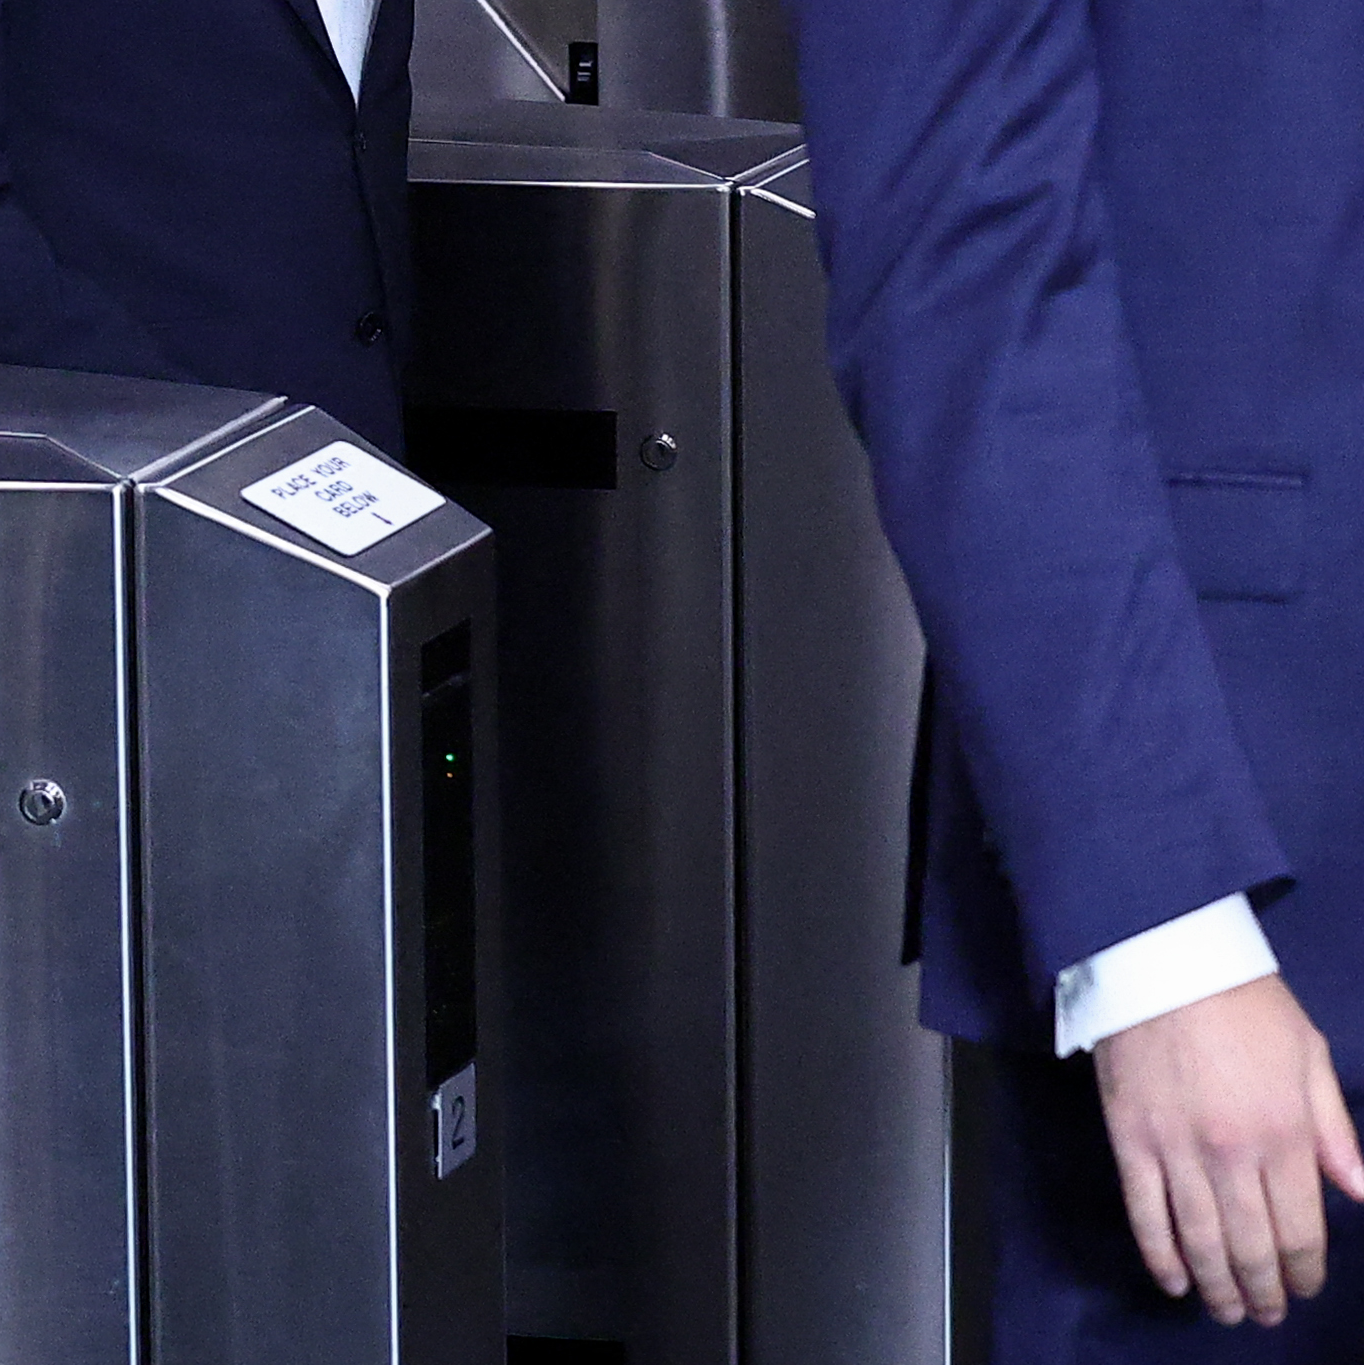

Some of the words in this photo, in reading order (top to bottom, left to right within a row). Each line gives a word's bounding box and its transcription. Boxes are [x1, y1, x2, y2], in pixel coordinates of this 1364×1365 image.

[271, 474, 317, 500] PLACE
[311, 457, 351, 478] YOUR
[314, 480, 354, 502] CARD
[332, 490, 379, 518] BELOW
[452, 1096, 465, 1149] 2
